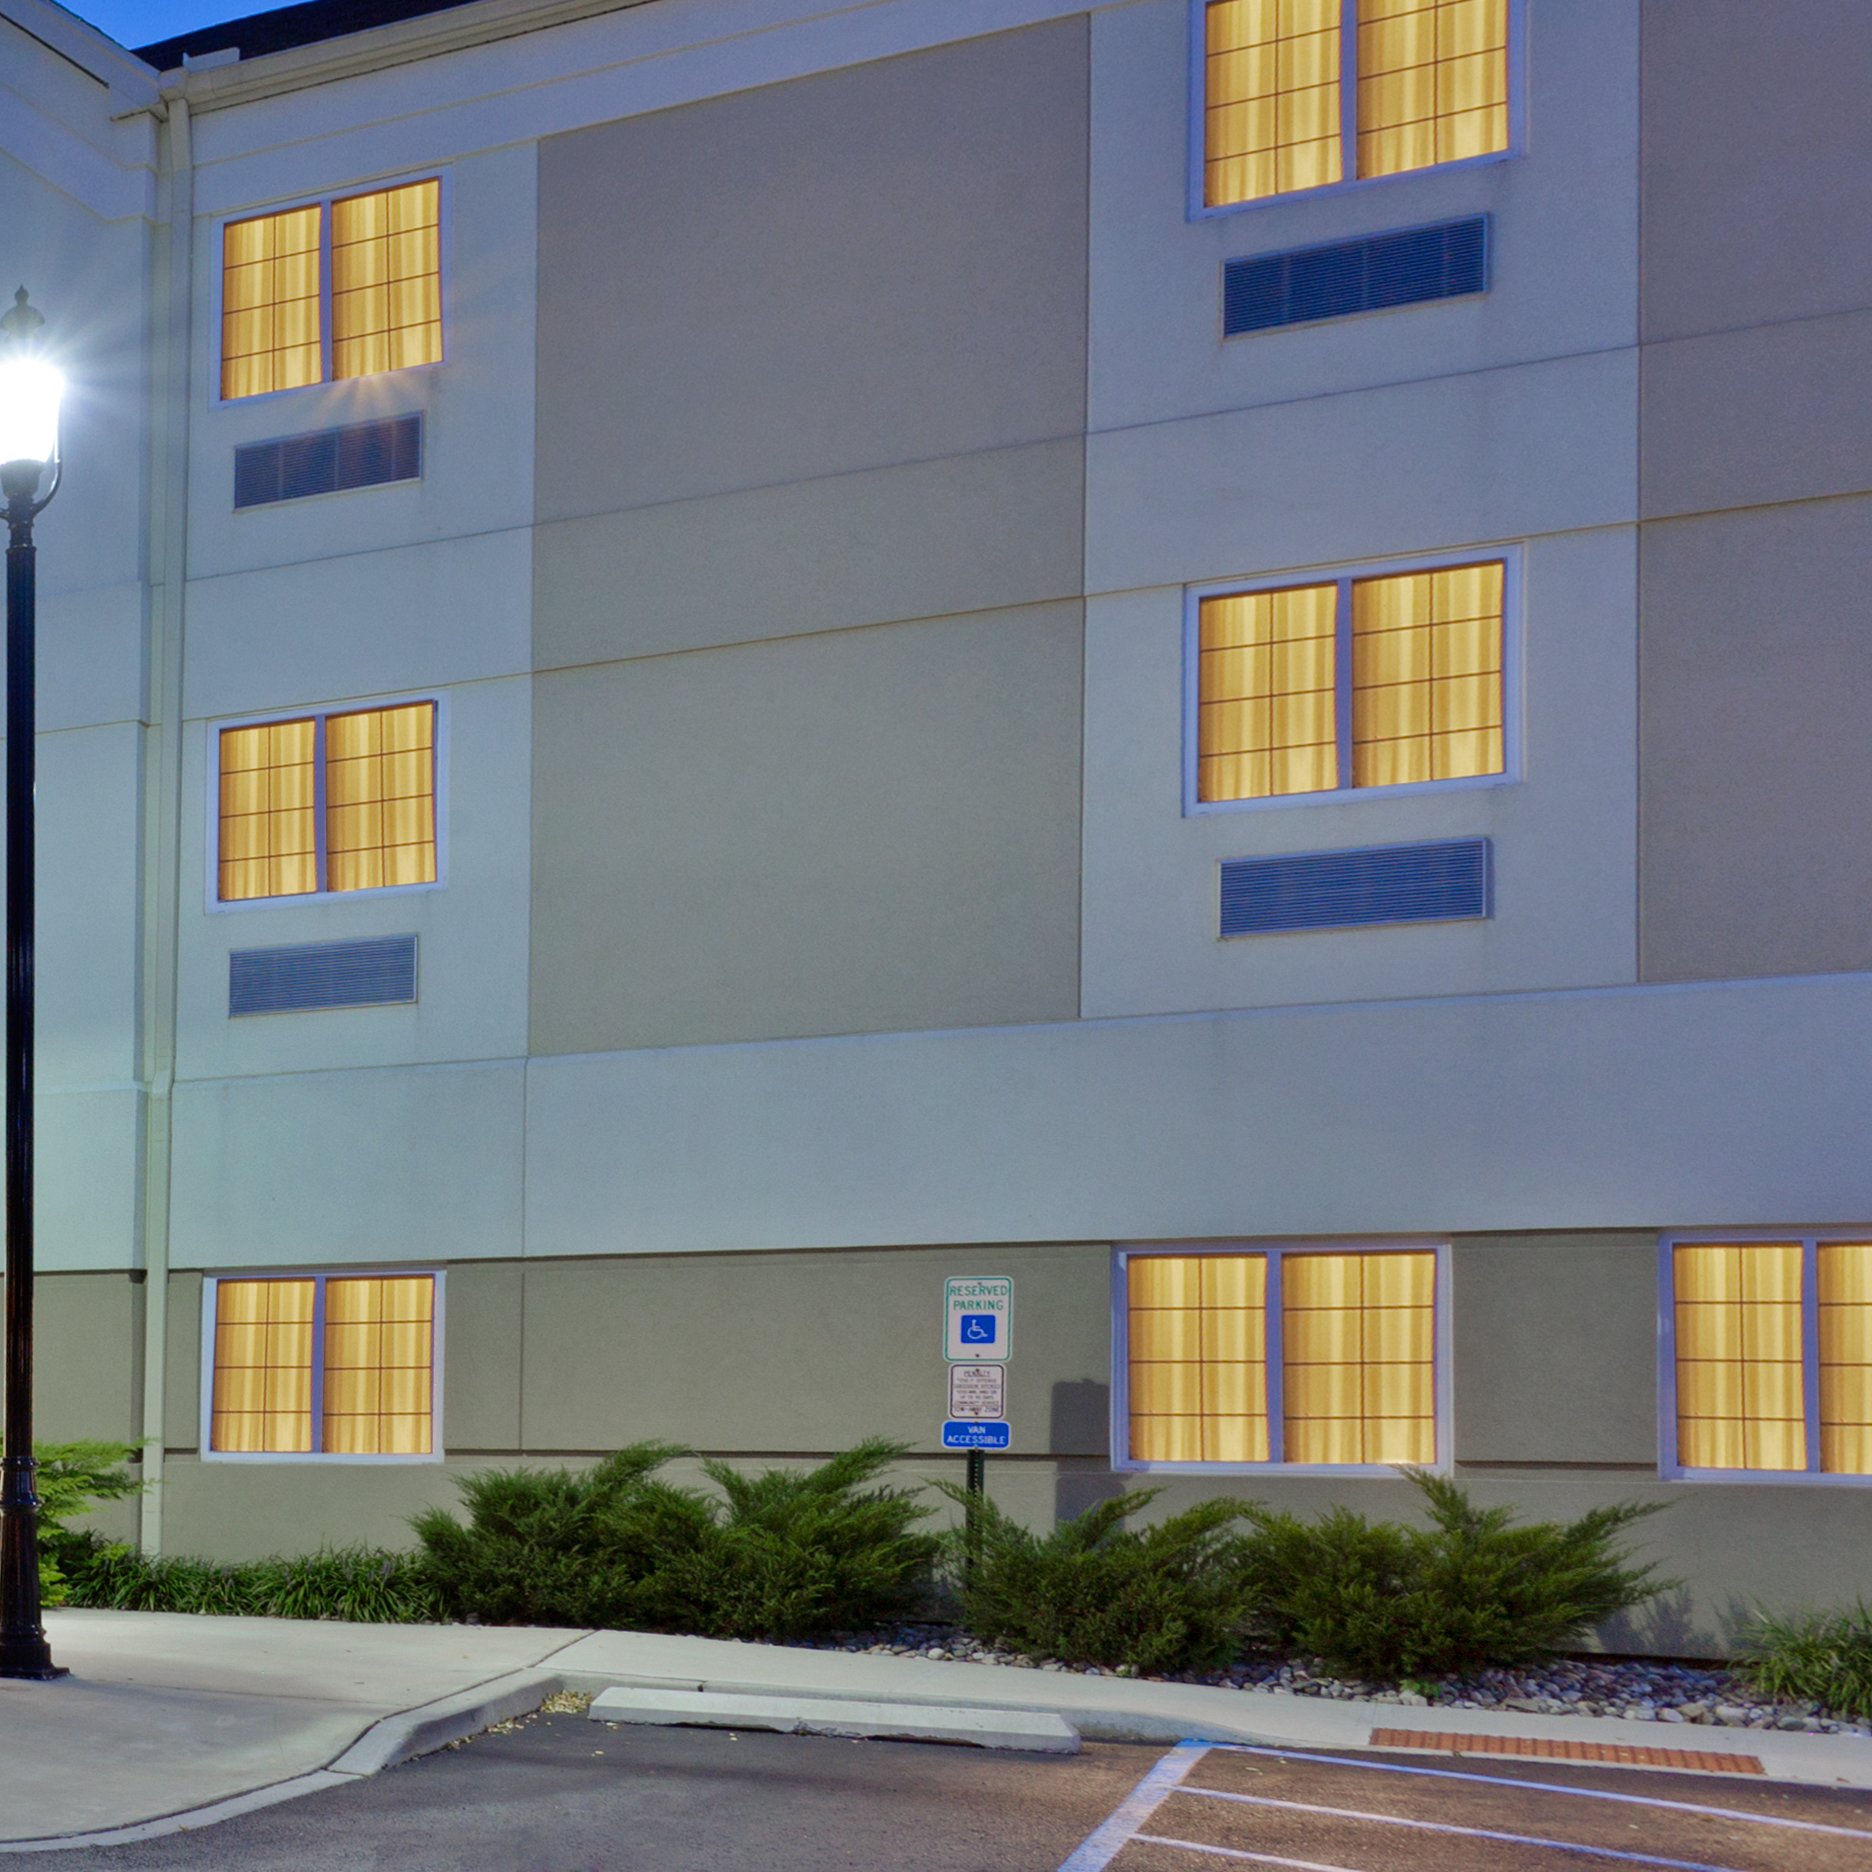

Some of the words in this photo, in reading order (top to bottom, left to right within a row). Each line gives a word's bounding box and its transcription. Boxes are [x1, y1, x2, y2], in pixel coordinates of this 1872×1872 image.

[949, 1285, 1008, 1297] RESERVED
[953, 1299, 1004, 1311] PARKING
[967, 1425, 986, 1434] VAN
[946, 1434, 1007, 1445] ACCESSIBLE
